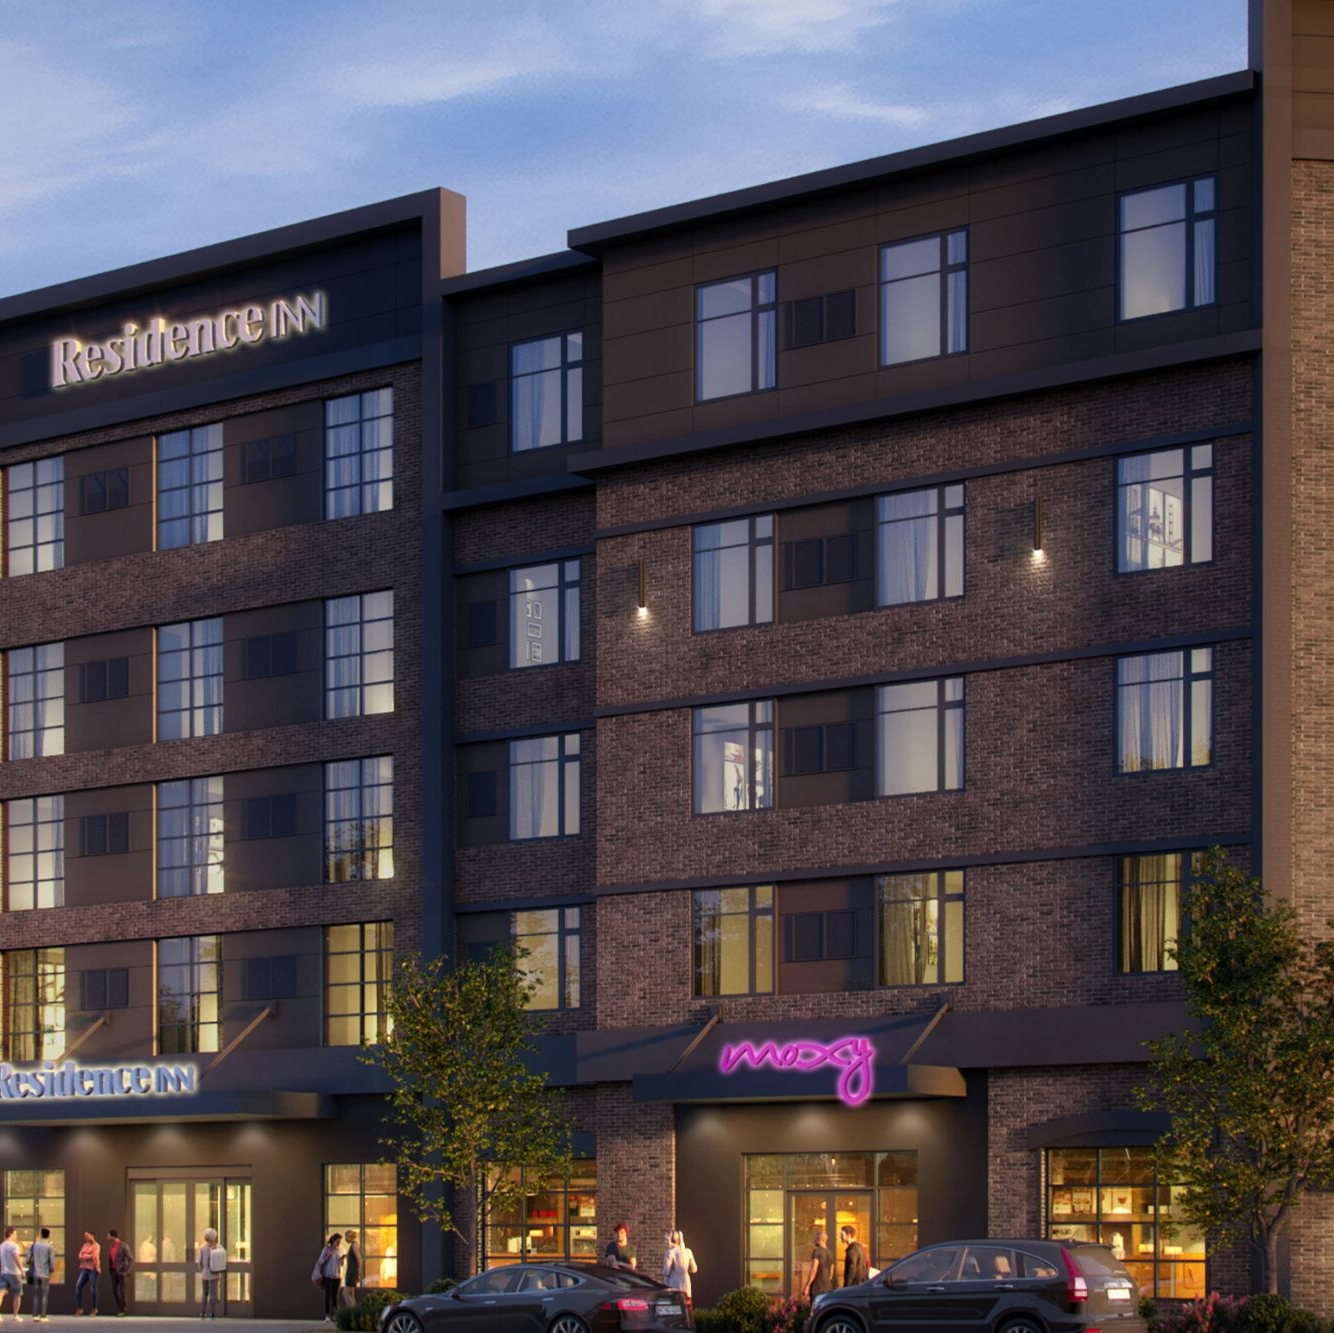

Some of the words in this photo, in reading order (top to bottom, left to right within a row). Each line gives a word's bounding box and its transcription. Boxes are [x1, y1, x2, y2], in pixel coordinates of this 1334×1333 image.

[51, 304, 264, 389] Residence
[270, 292, 326, 338] INN
[154, 1064, 195, 1094] INN
[720, 1036, 875, 1107] moxy
